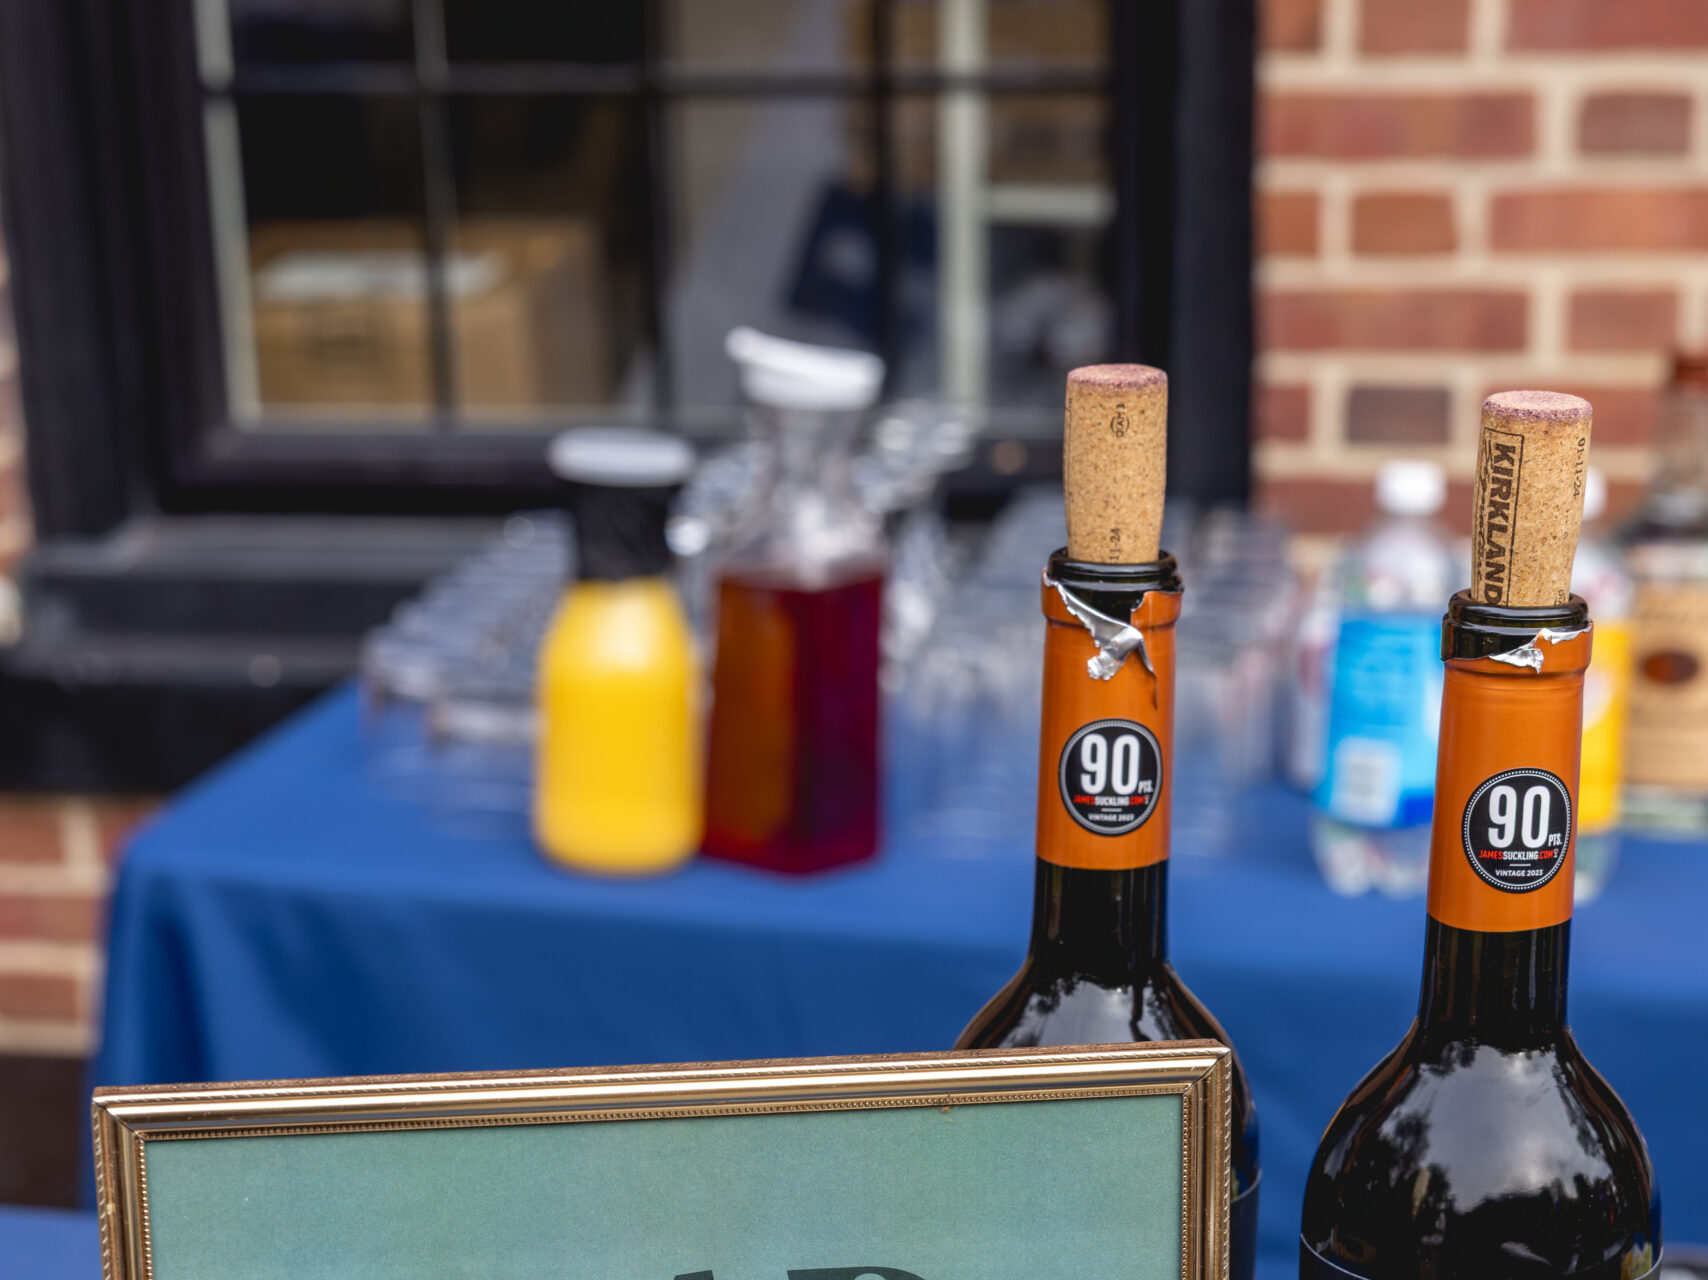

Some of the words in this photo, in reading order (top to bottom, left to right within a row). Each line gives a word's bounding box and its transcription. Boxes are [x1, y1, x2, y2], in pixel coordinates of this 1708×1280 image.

[1572, 436, 1586, 498] 01-11-24
[1484, 442, 1516, 605] KIRKLAND
[1081, 733, 1140, 796] 90
[1487, 785, 1551, 849] 90
[1548, 832, 1563, 847] PTS.
[1478, 849, 1554, 861] JAMESSUCKLING.COM
[1495, 869, 1526, 877] VINTAGE
[1526, 869, 1543, 877] 2023
